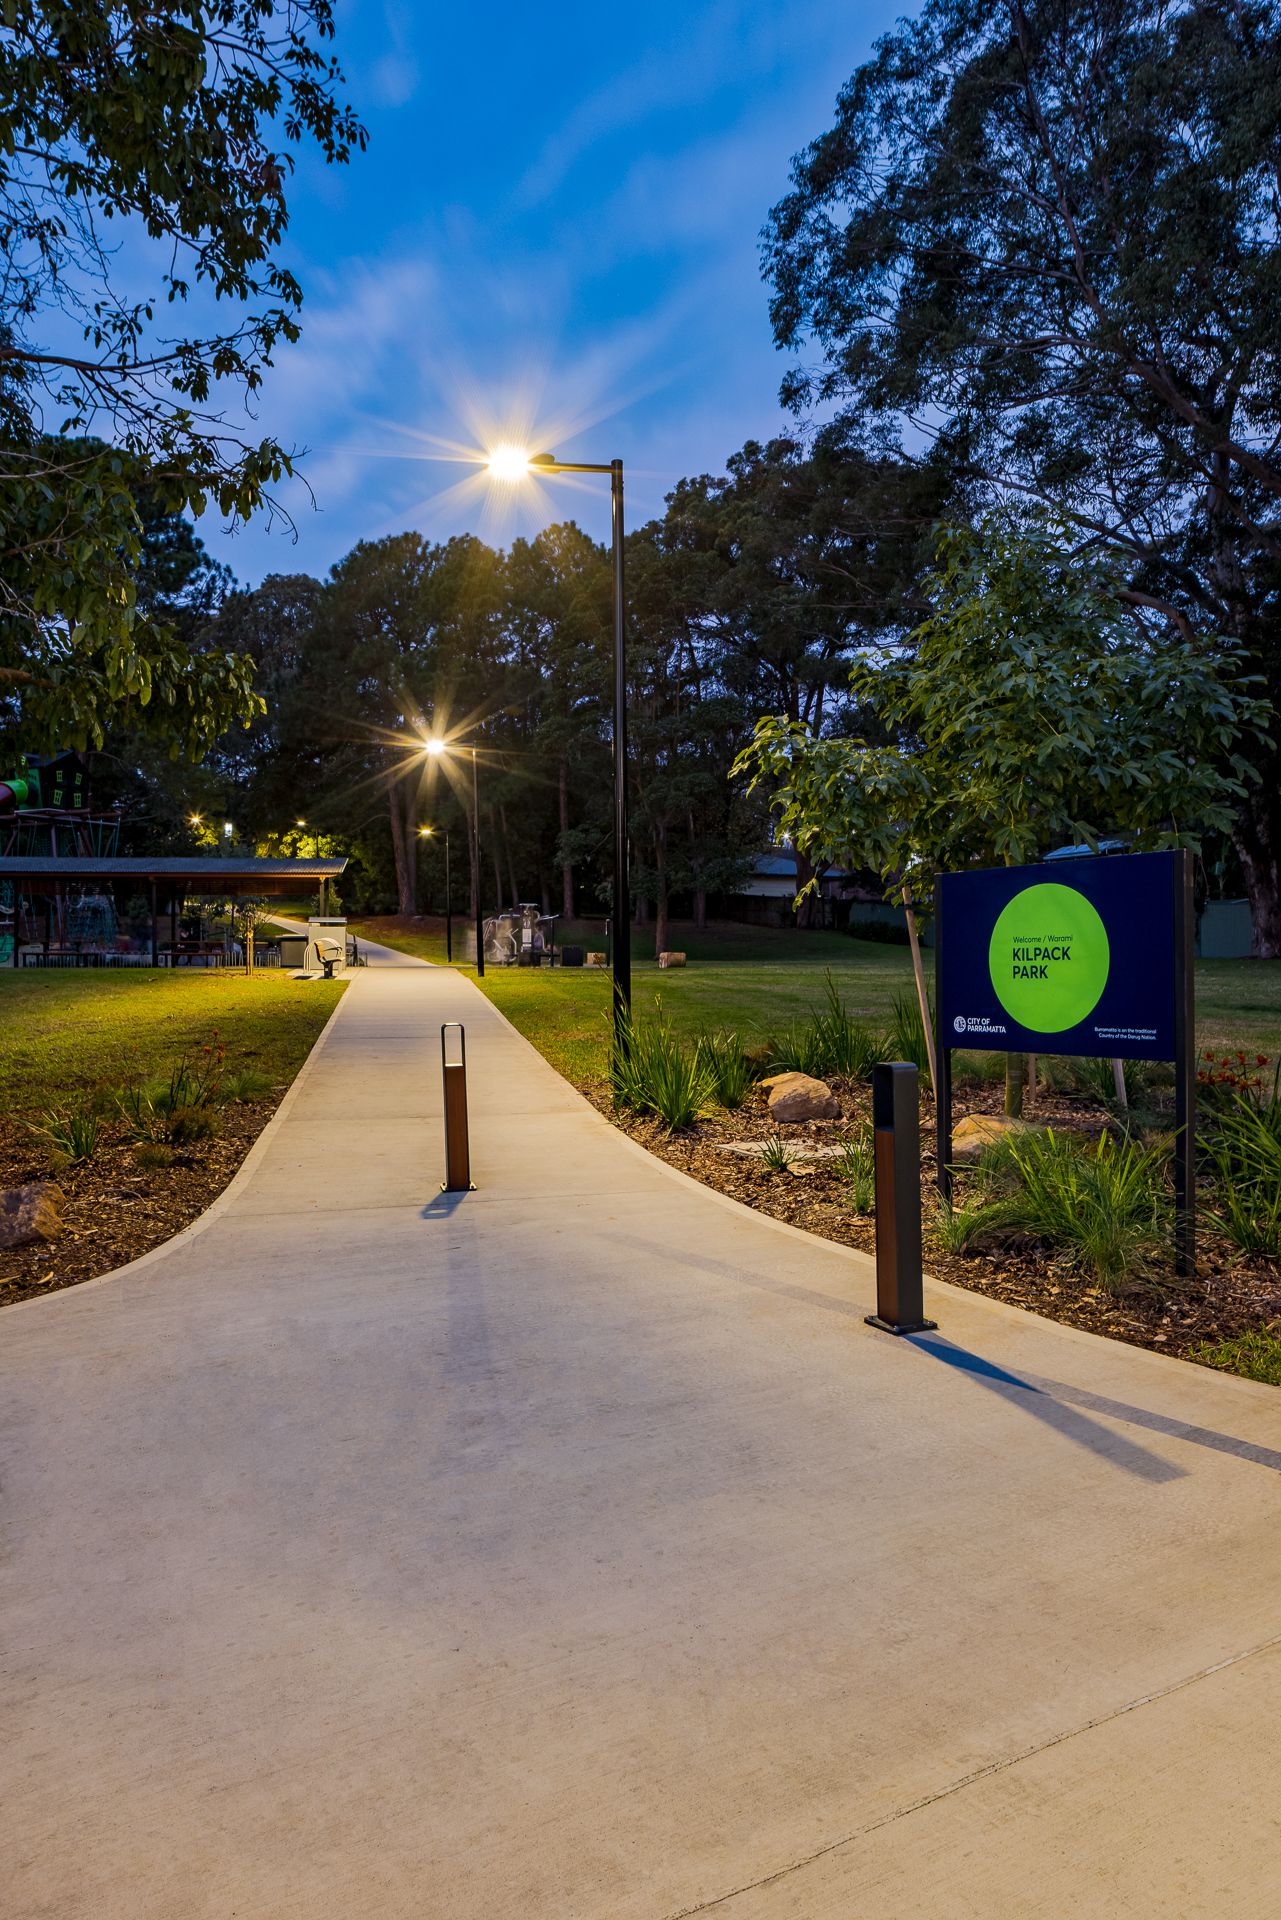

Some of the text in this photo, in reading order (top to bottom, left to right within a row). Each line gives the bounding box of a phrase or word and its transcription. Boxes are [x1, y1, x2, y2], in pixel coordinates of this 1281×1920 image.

[1048, 934, 1073, 942] Warami
[1013, 946, 1071, 961] KILPACK
[1013, 965, 1048, 979] PARK
[967, 1017, 980, 1025] CITY
[967, 1025, 1006, 1033] PARRAMATTA
